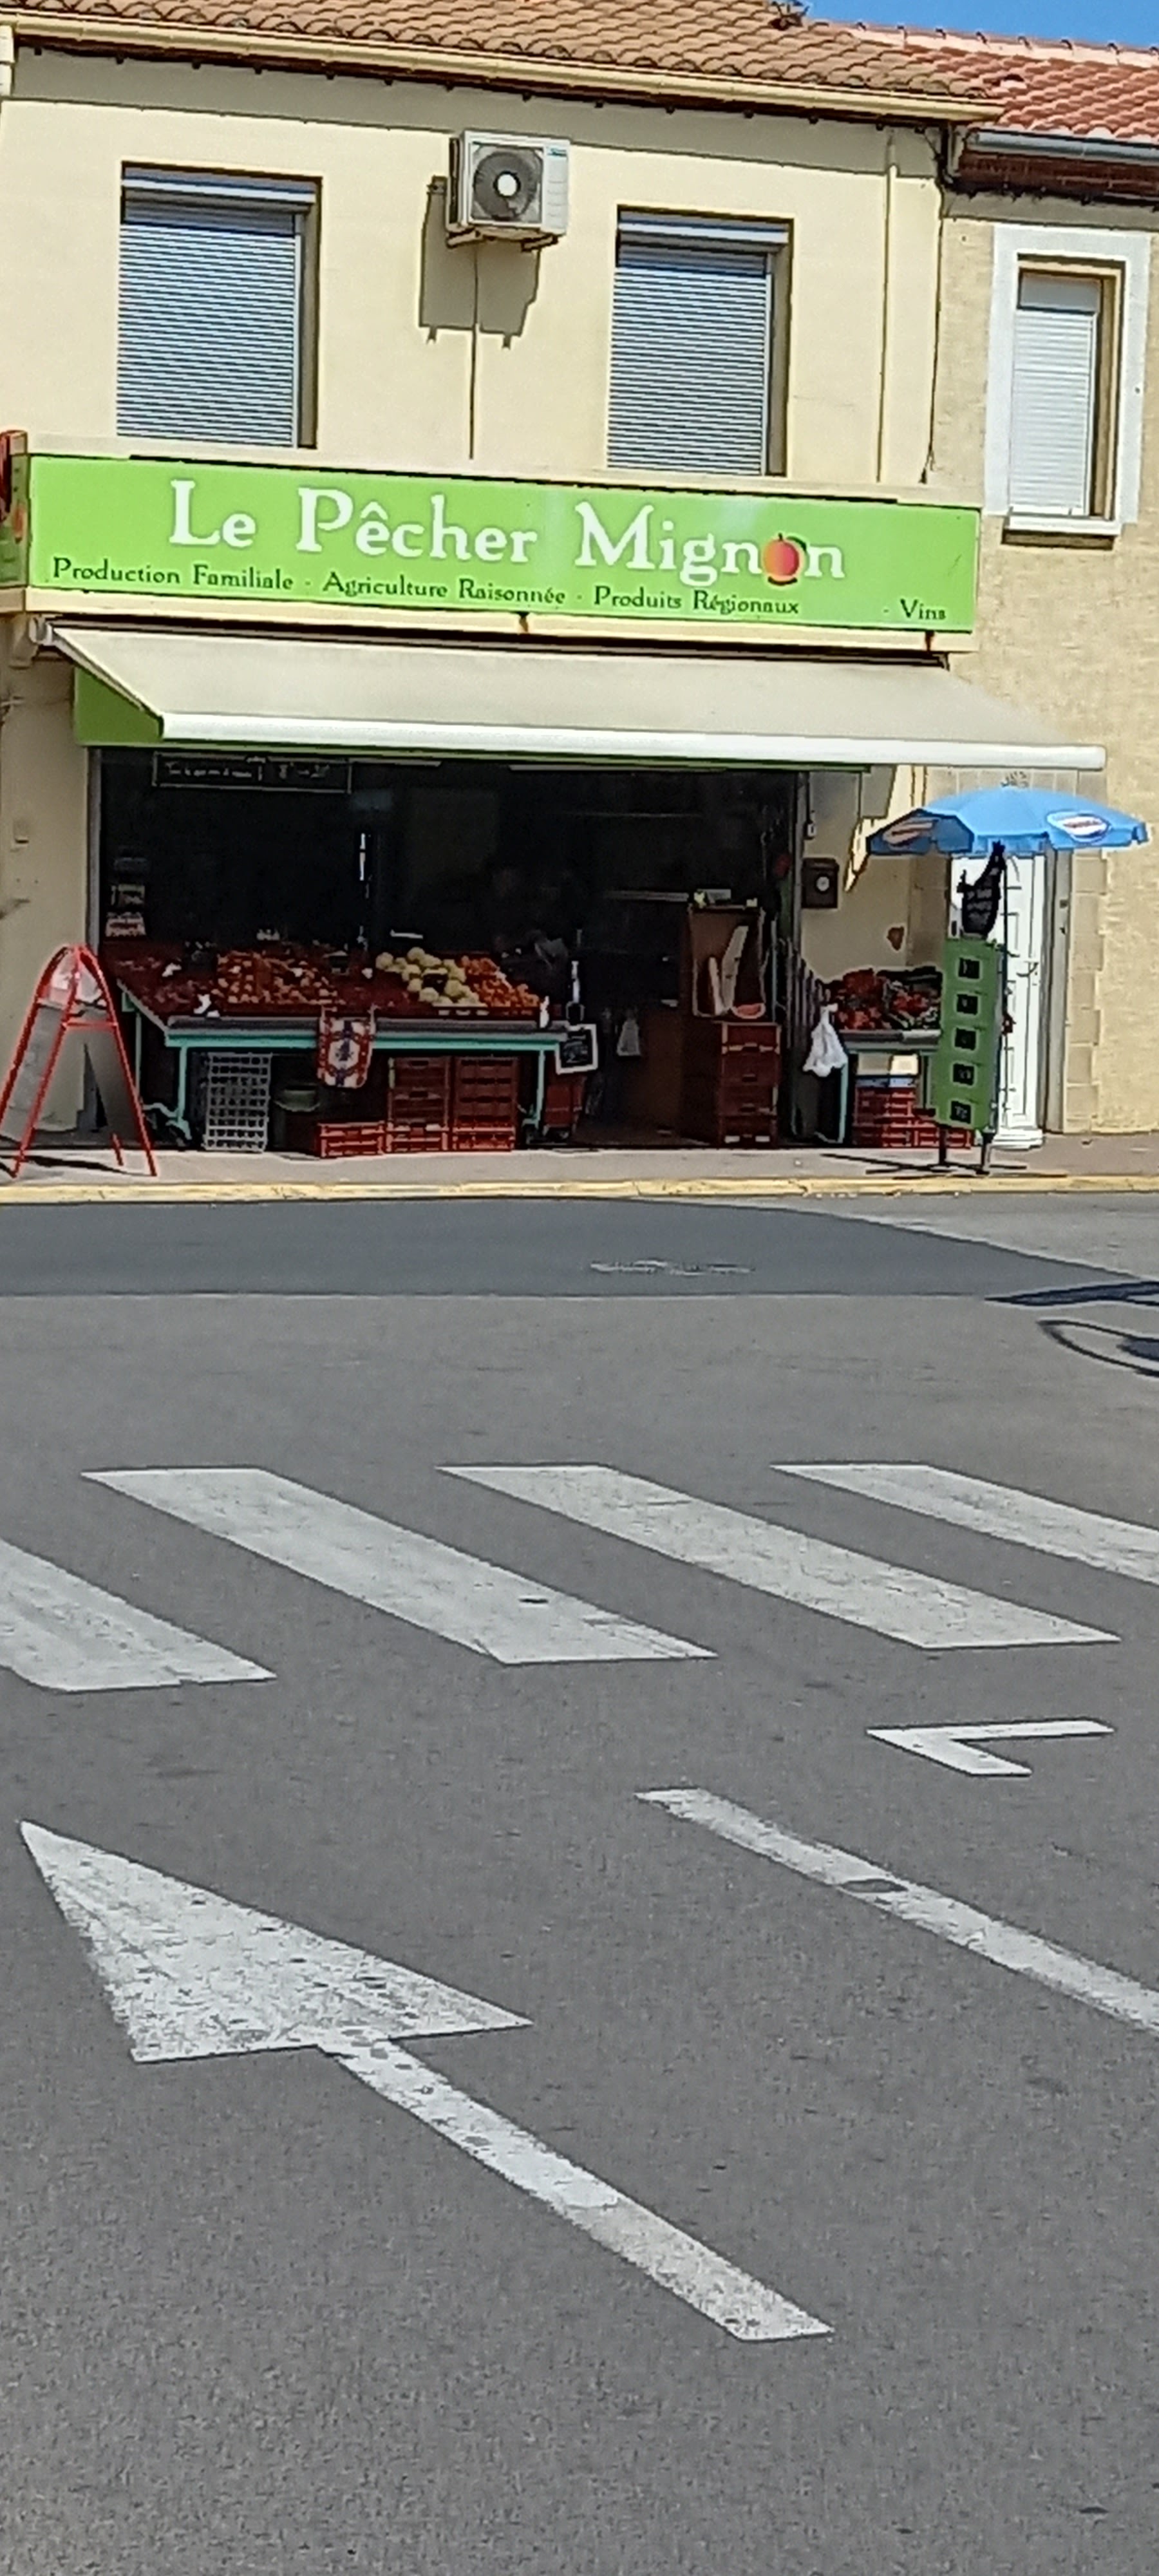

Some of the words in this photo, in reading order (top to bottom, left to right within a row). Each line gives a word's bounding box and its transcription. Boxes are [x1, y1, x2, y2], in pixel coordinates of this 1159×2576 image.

[169, 480, 256, 547] Le
[296, 486, 538, 562] Pêcher
[53, 556, 180, 584] Production
[193, 564, 294, 590] Familiale
[322, 571, 449, 598] Agriculture
[458, 578, 566, 604] Raisonnée
[594, 585, 683, 609] Produits
[693, 589, 800, 615] Régionaux
[900, 598, 947, 620] Vins
